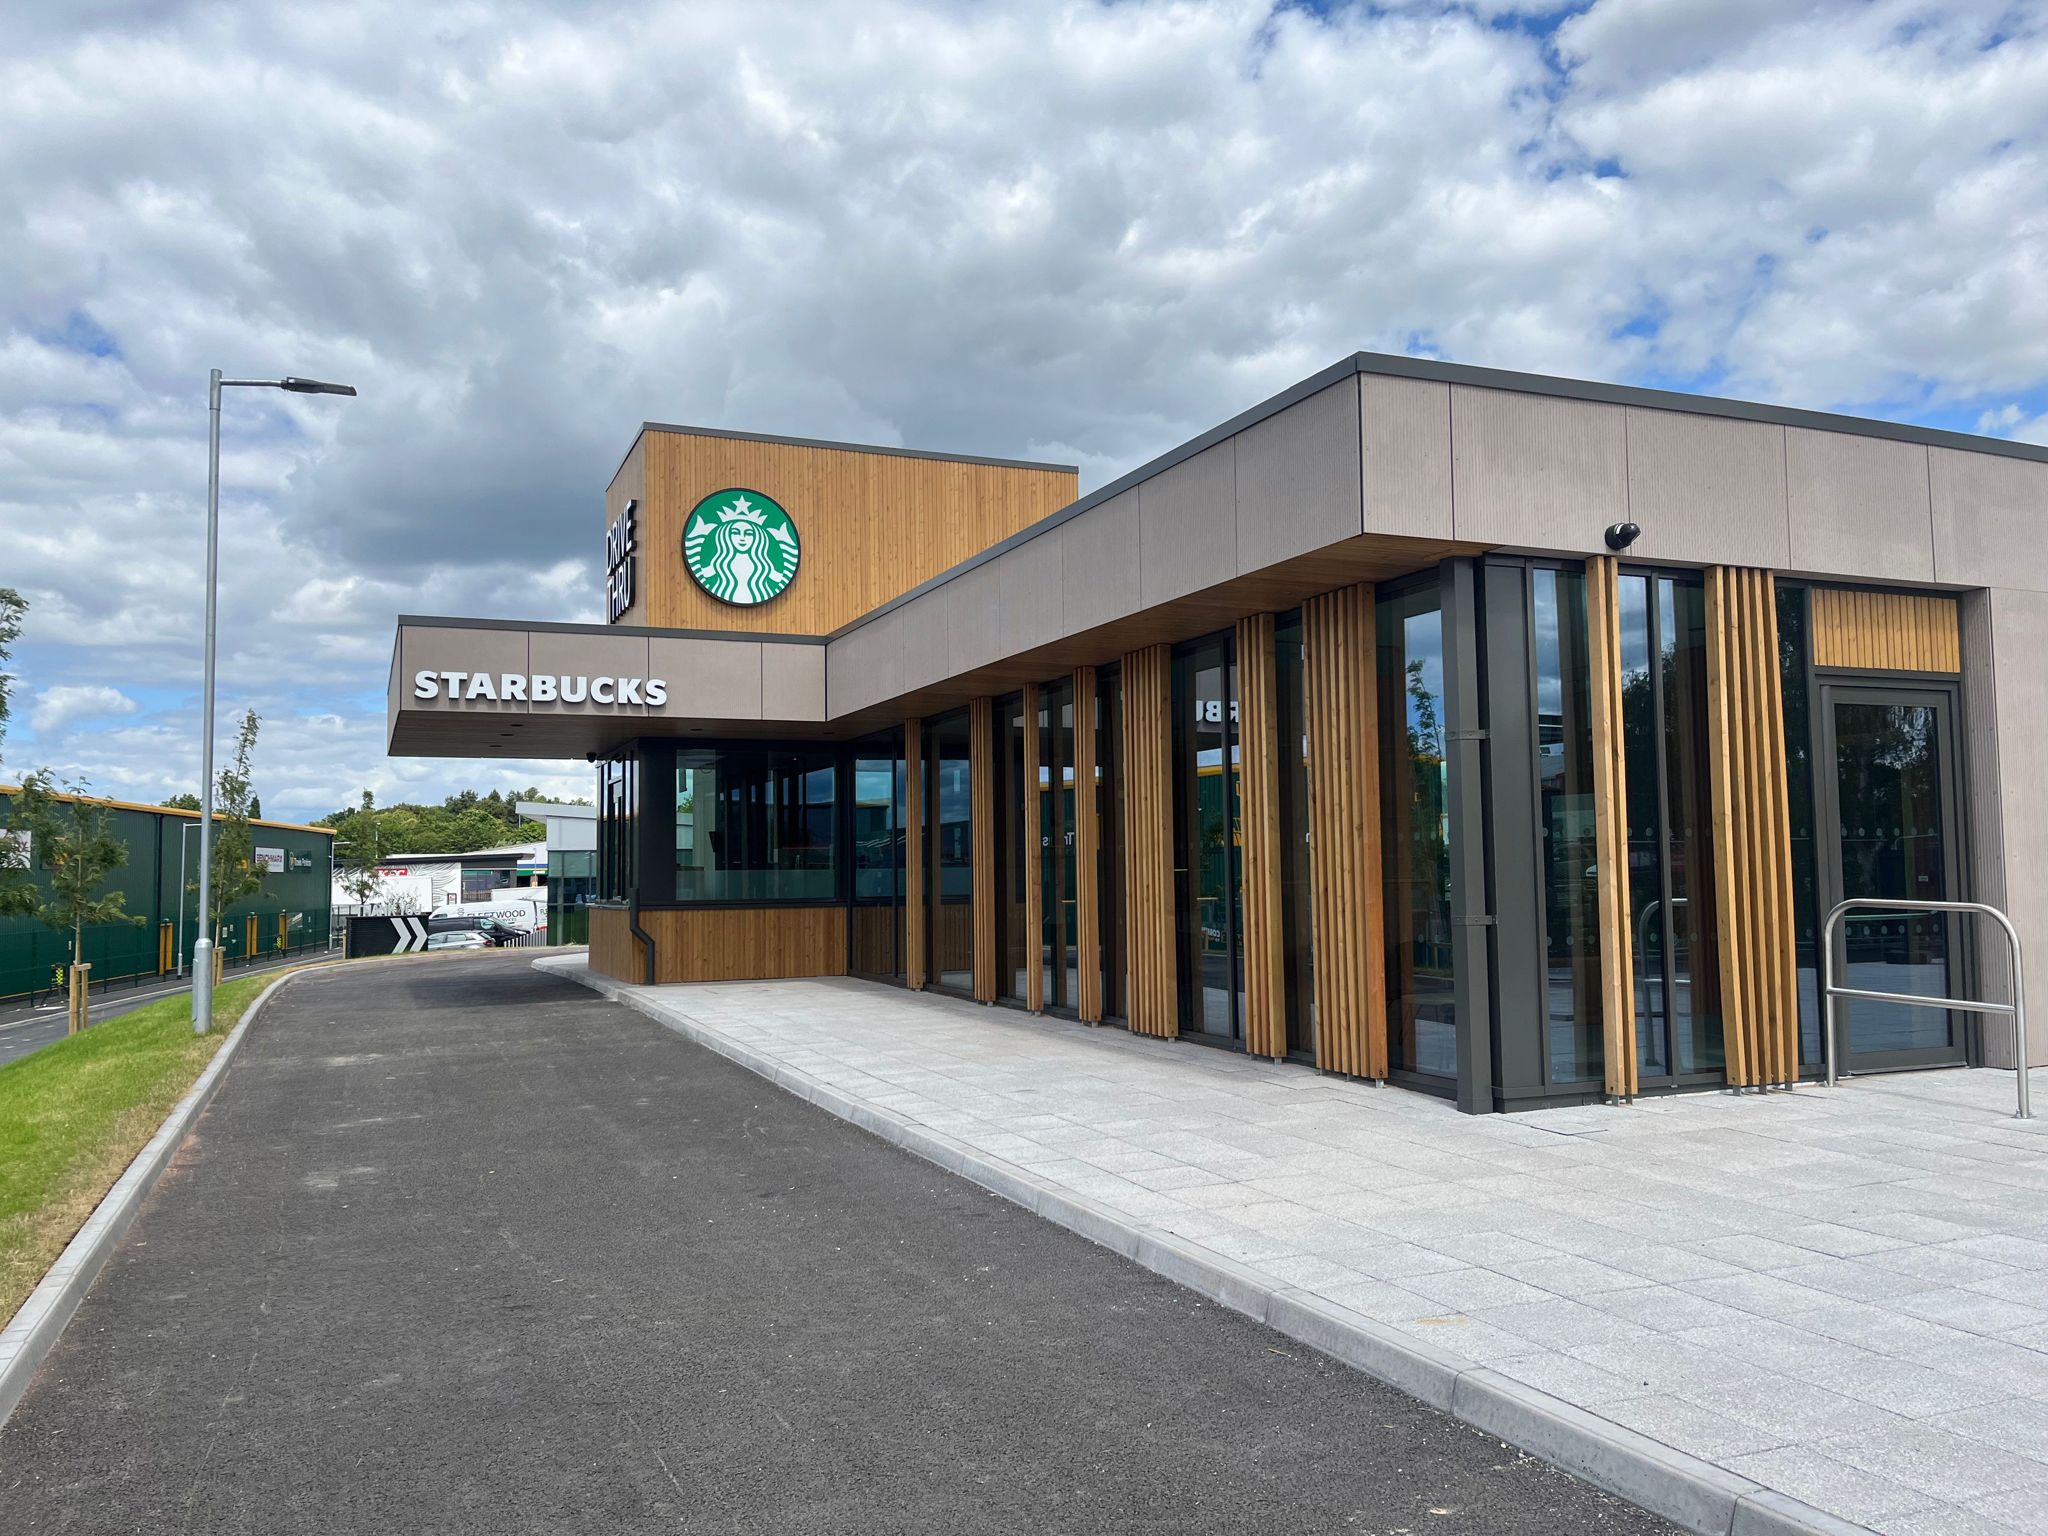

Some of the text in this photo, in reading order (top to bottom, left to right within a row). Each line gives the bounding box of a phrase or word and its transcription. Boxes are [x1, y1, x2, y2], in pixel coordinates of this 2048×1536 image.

[606, 499, 635, 576] DRIVE
[607, 556, 634, 624] THRU
[414, 670, 667, 707] STARBUCKS
